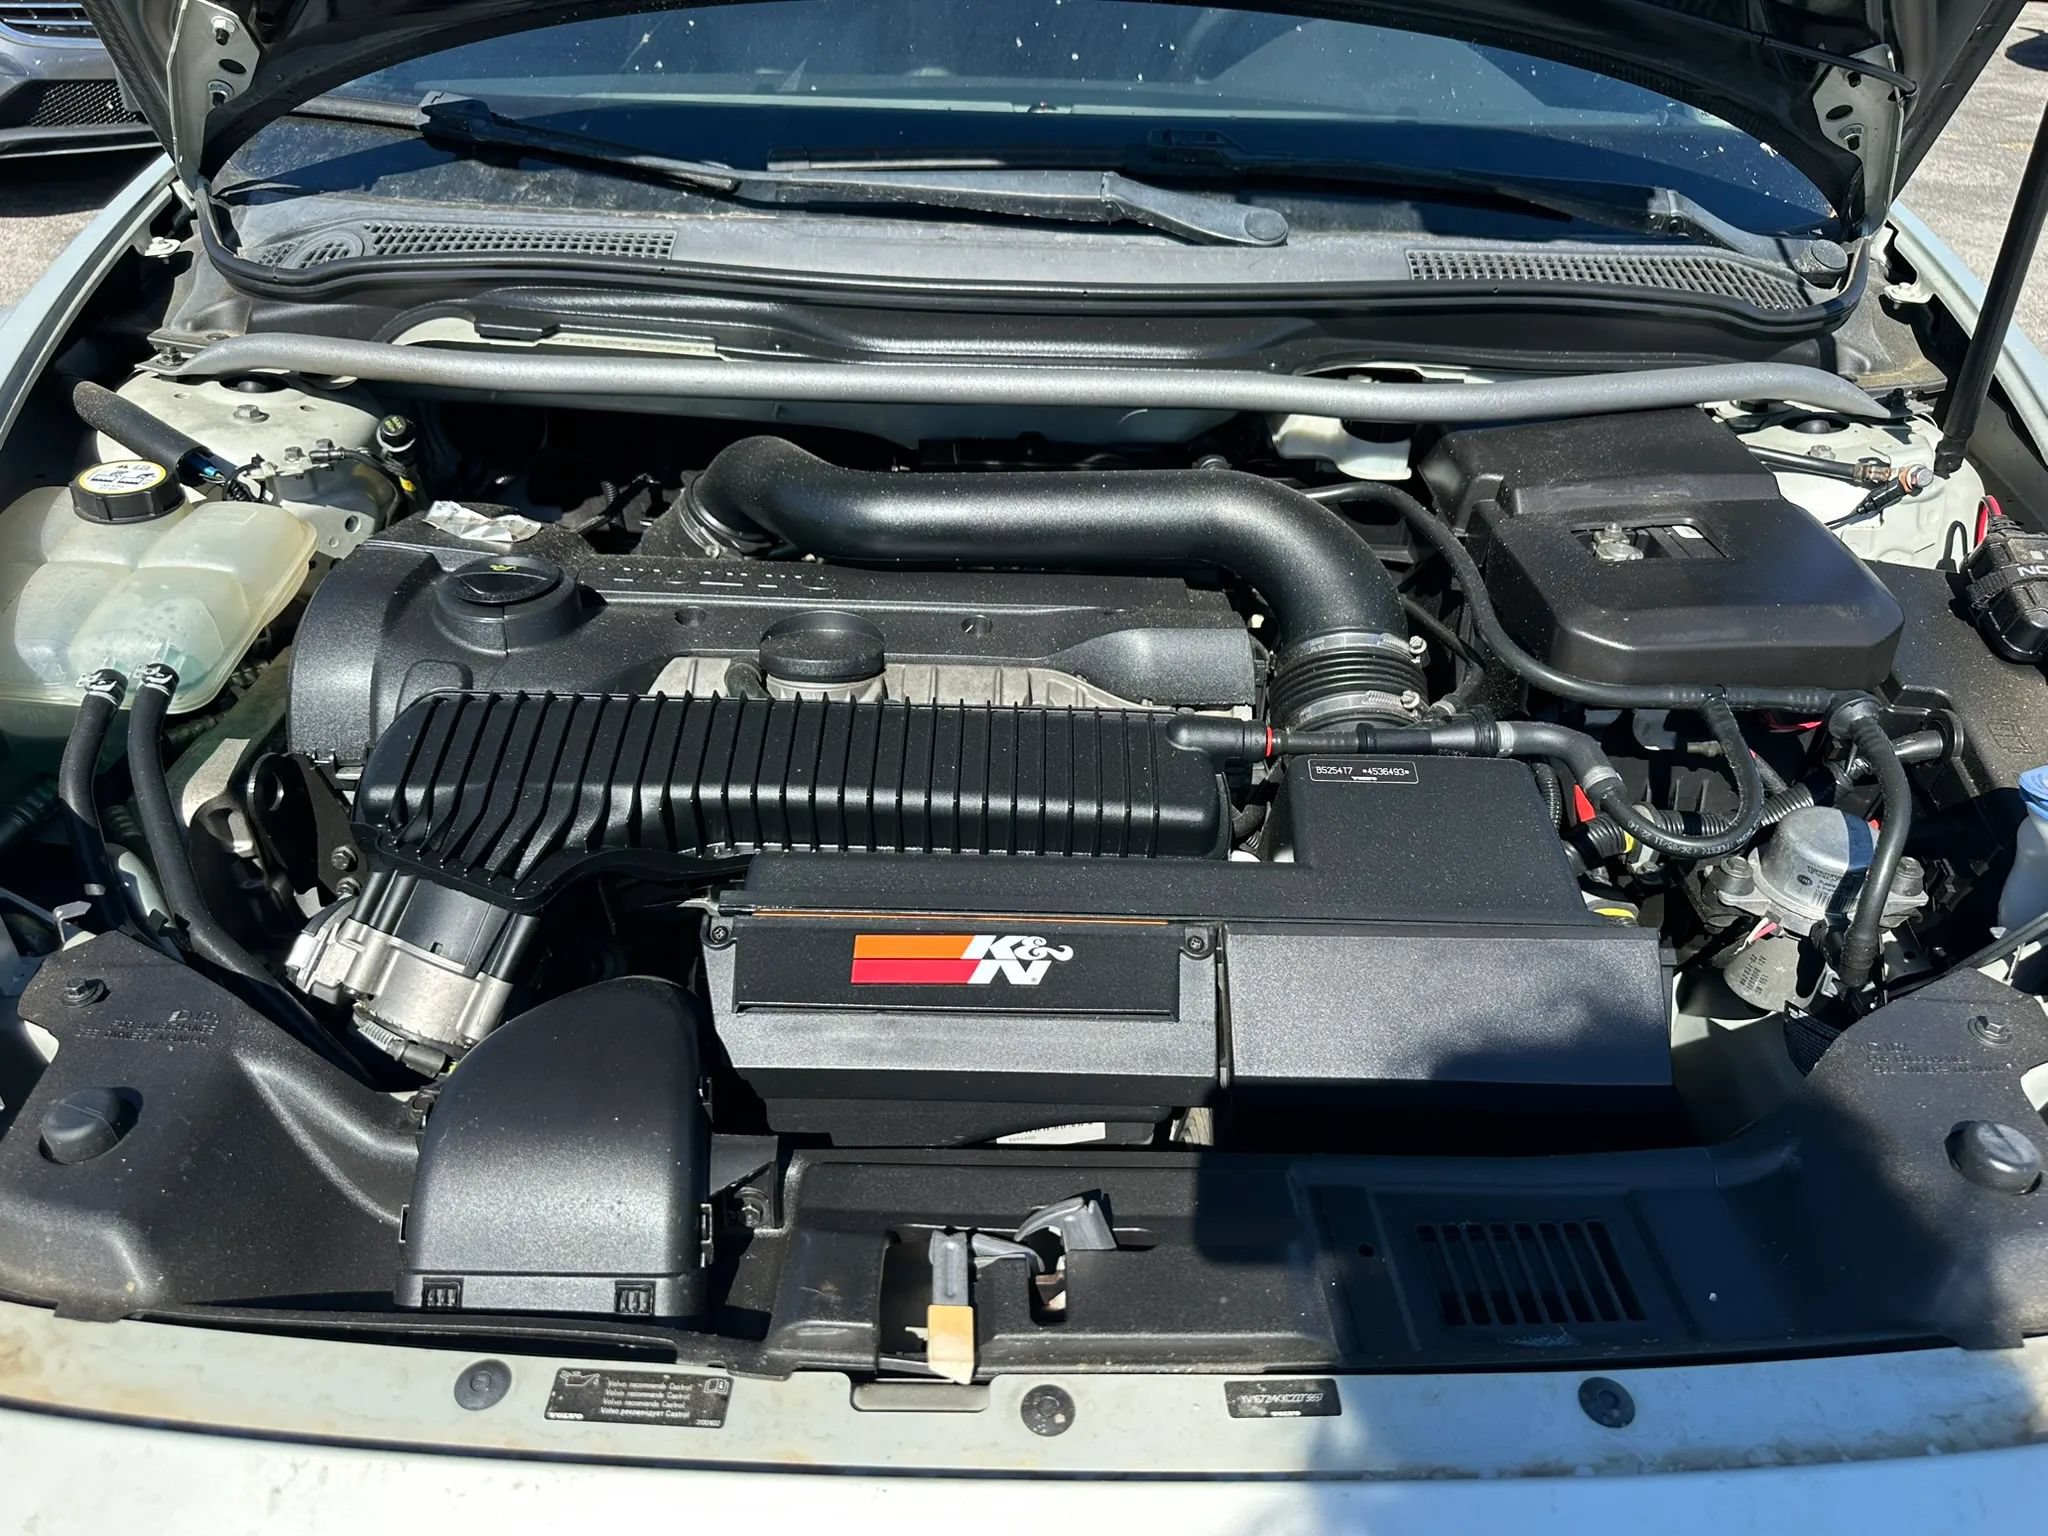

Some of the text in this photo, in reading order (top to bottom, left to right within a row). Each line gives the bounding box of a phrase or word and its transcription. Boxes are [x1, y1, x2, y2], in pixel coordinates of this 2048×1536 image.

[960, 934, 1074, 985] K&N
[607, 1379, 626, 1388] Volvo
[669, 1382, 693, 1391] Castrol
[605, 1389, 625, 1397] Volvo
[667, 1391, 690, 1400] Castrol
[603, 1398, 622, 1407] Volvo
[662, 1400, 686, 1409] Castrol
[600, 1407, 620, 1415] Volvo
[665, 1410, 690, 1418] Castrol
